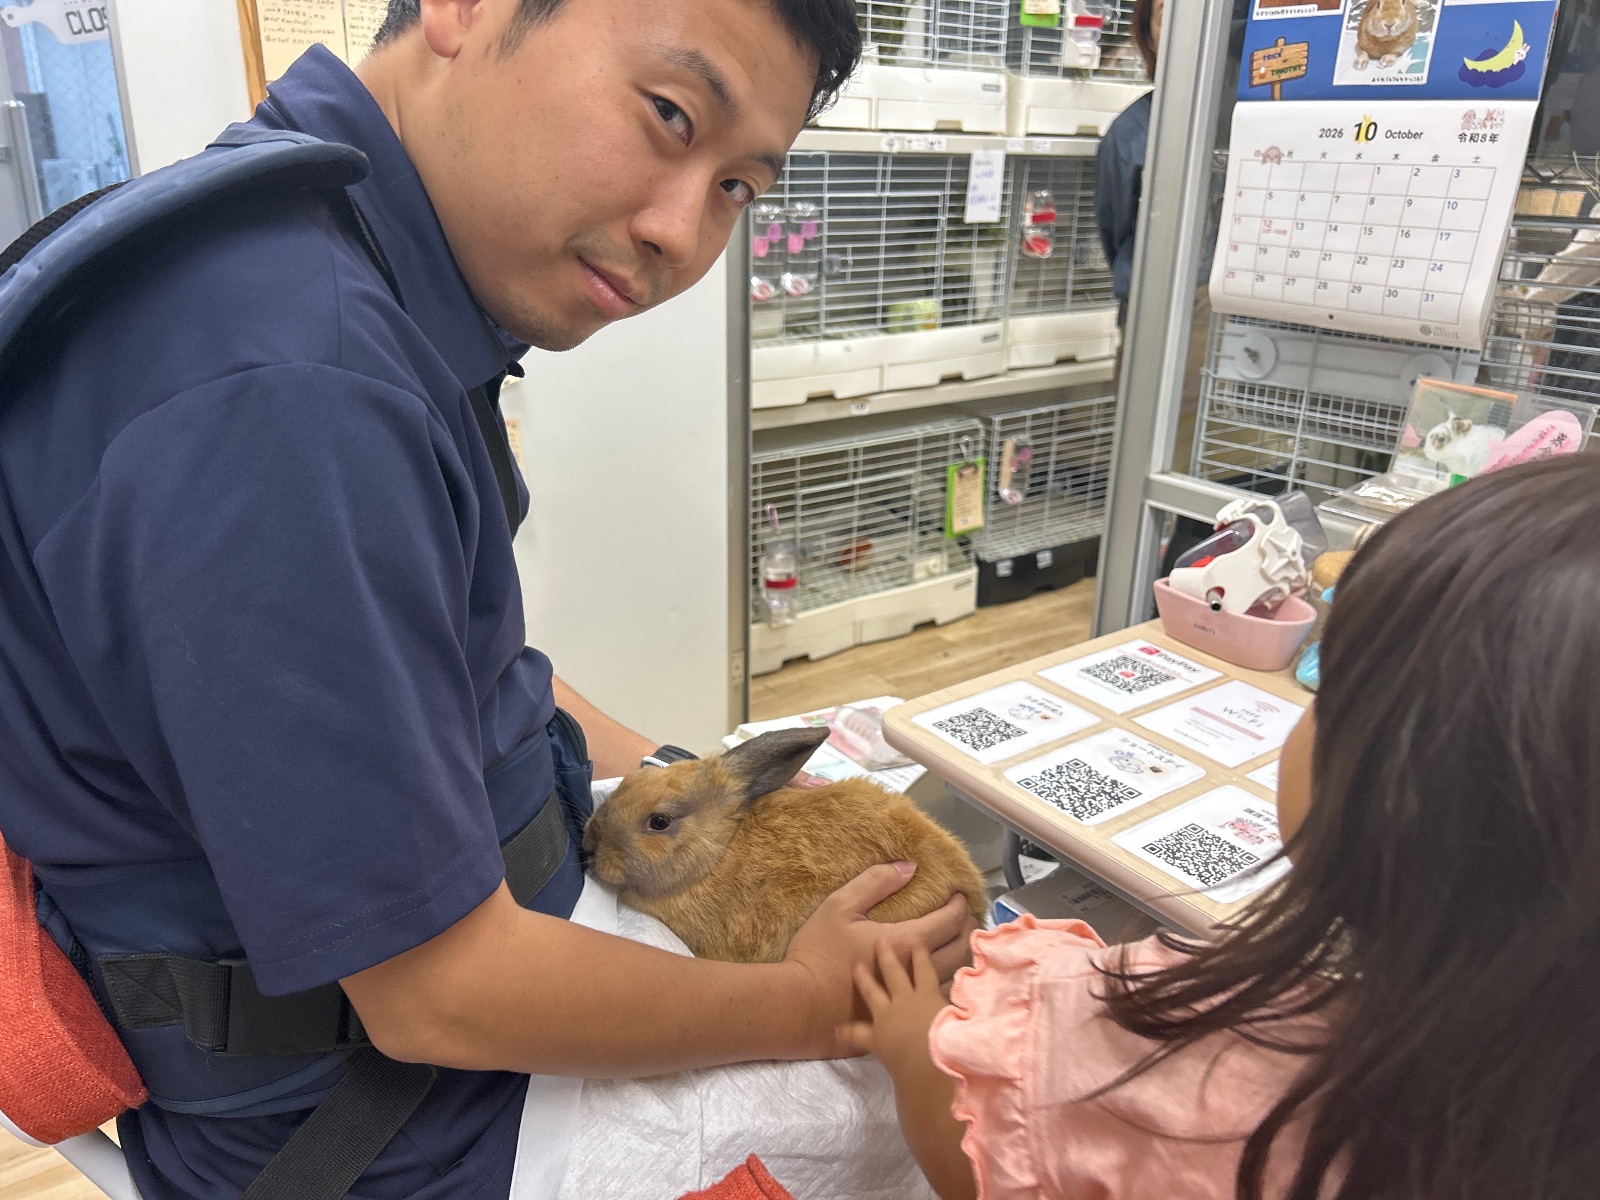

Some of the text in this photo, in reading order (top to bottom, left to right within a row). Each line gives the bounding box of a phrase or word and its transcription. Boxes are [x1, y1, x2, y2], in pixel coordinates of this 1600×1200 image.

[65, 7, 107, 35] CLO
[1263, 52, 1282, 61] TRICK
[1270, 64, 1303, 76] TIMOTHY
[1319, 122, 1424, 142] 2026 10 October
[1458, 132, 1500, 144] 令和8年
[1413, 168, 1421, 177] 2
[1453, 169, 1461, 178] 3
[1268, 192, 1274, 200] 5
[1299, 193, 1306, 202] 6
[1334, 195, 1341, 203] 7
[1369, 197, 1375, 206] 8
[1406, 198, 1413, 207] 9
[1447, 201, 1458, 210] 10
[1263, 219, 1273, 228] 12
[1295, 222, 1304, 231] 13
[1329, 224, 1338, 233] 14
[1363, 226, 1373, 235] 15
[1400, 229, 1411, 239] 16
[1439, 232, 1451, 241] 17
[1258, 246, 1268, 255] 19
[1289, 250, 1300, 259] 20
[1322, 253, 1332, 262] 21
[1356, 256, 1368, 265] 22
[1392, 259, 1405, 269] 23
[1430, 263, 1443, 272] 24
[1225, 270, 1434, 303] 25 26 27 28 29 30 31
[1157, 652, 1201, 673] PayPay
